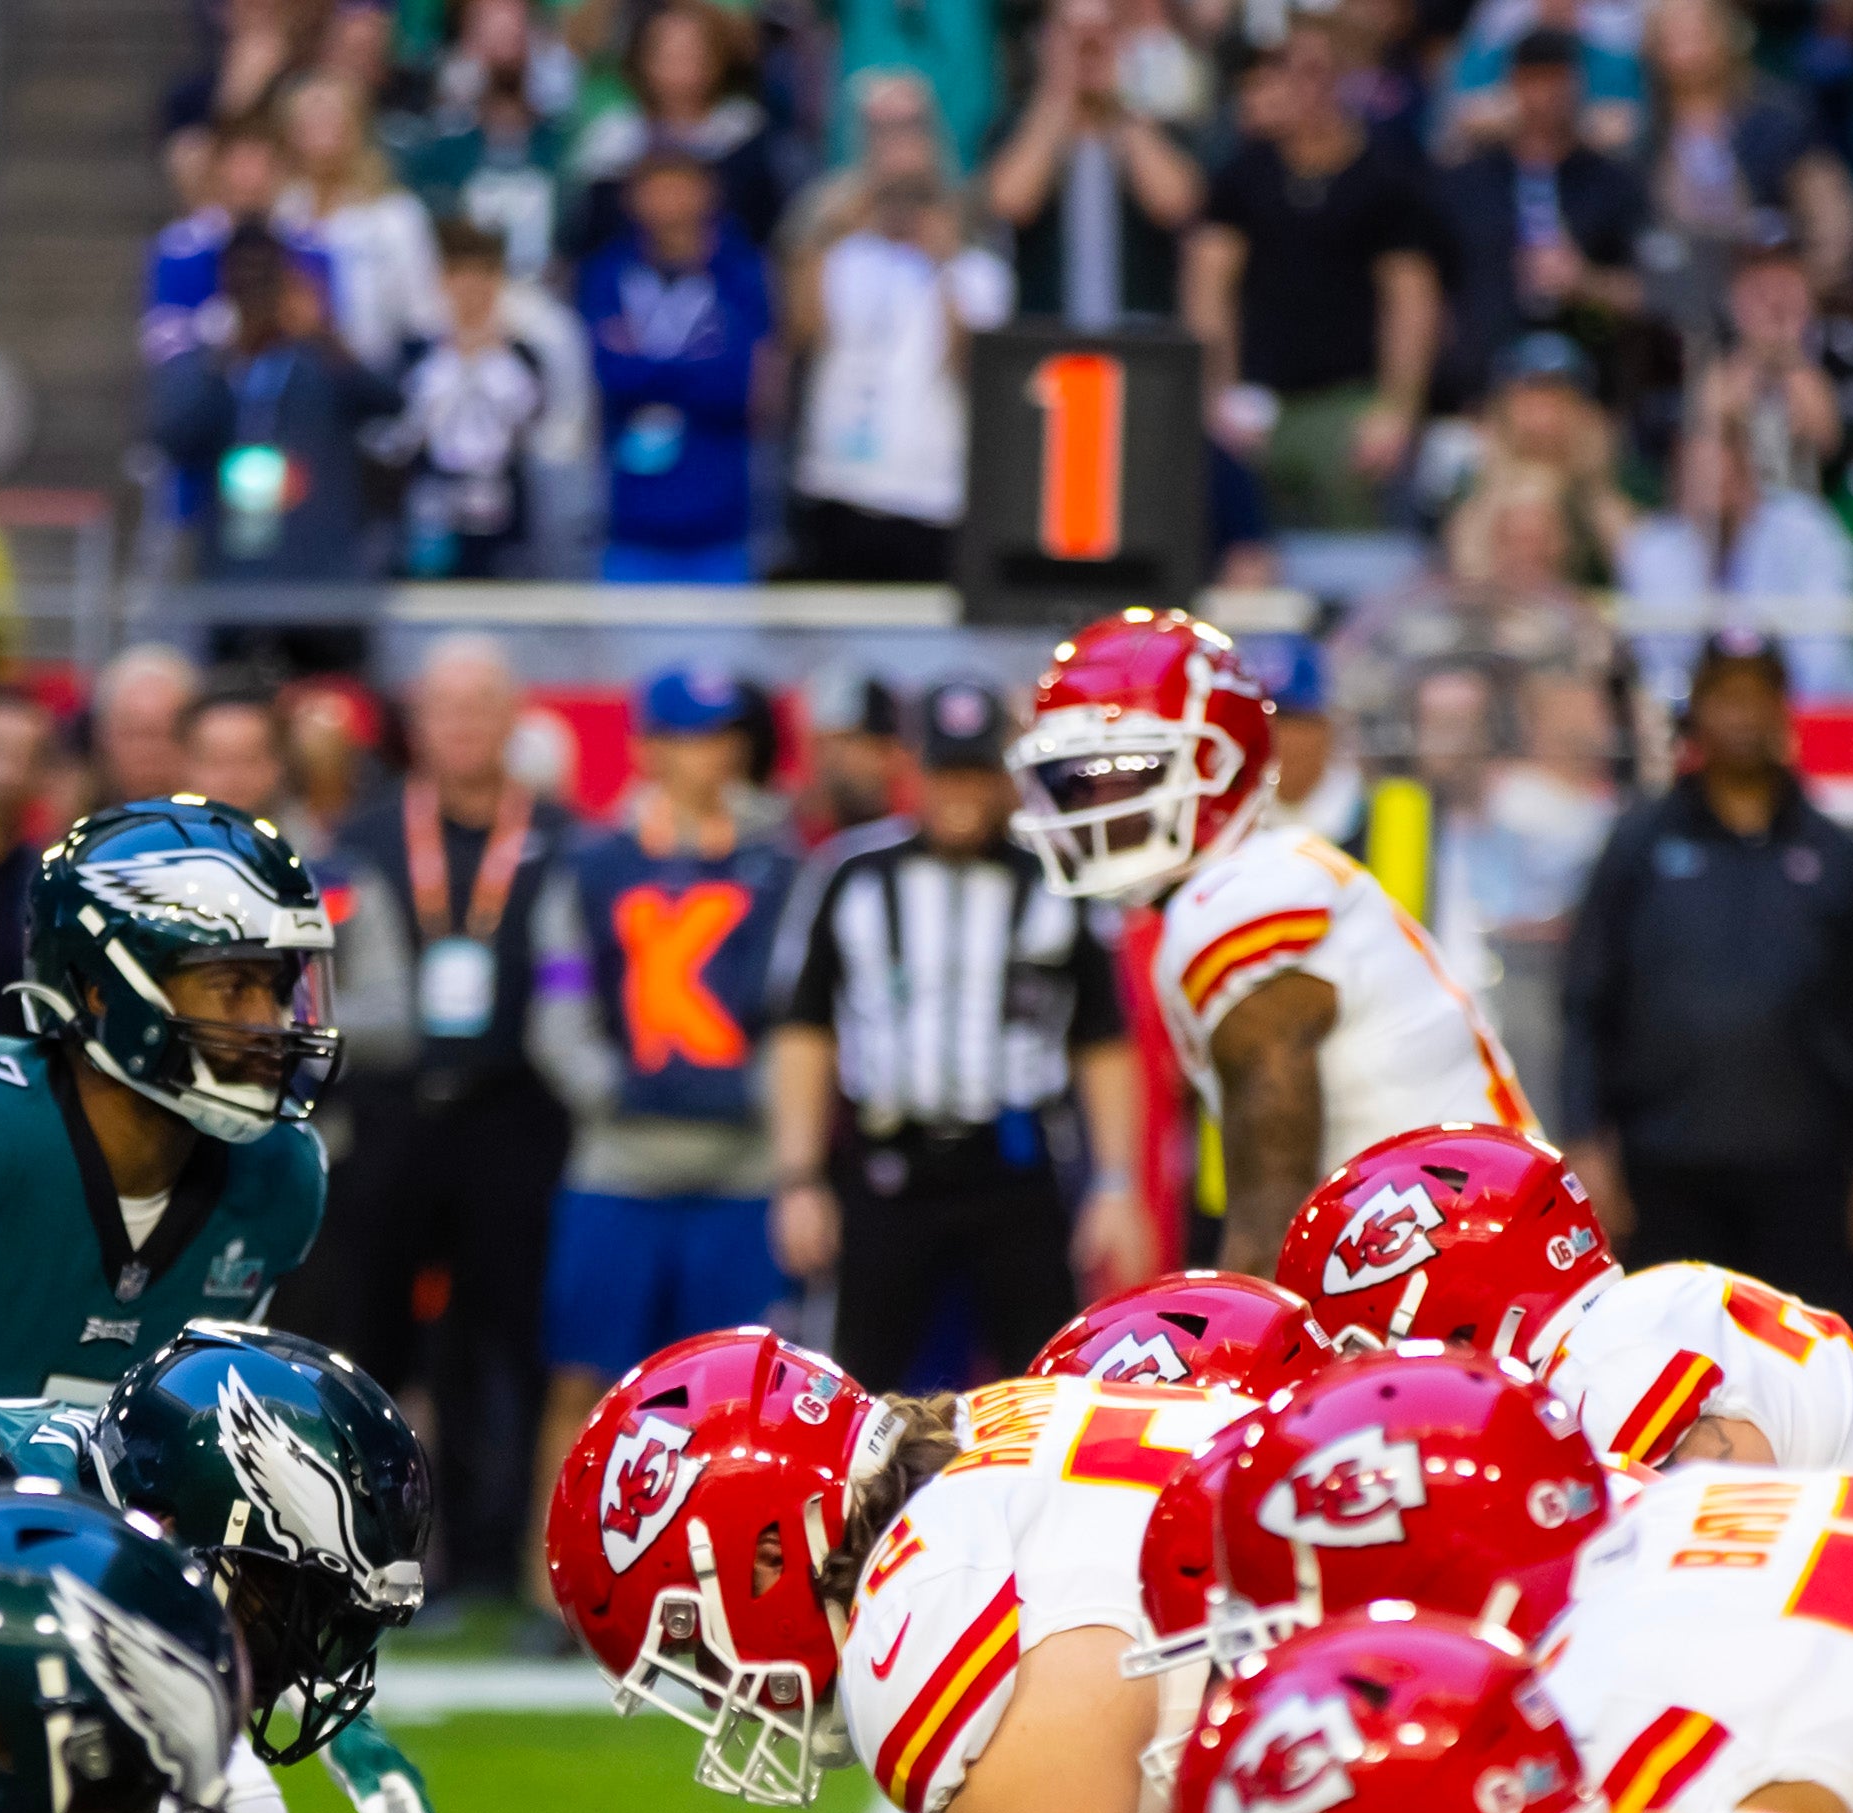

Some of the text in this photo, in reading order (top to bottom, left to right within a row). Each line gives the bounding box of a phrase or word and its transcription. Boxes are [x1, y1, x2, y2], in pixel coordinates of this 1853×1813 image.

[1030, 352, 1124, 561] 1
[612, 881, 752, 1073] K
[1333, 1204, 1418, 1279] KC
[1550, 1239, 1573, 1267] 16
[796, 1395, 826, 1422] 16
[868, 1438, 881, 1456] IT
[602, 1438, 681, 1543] KC
